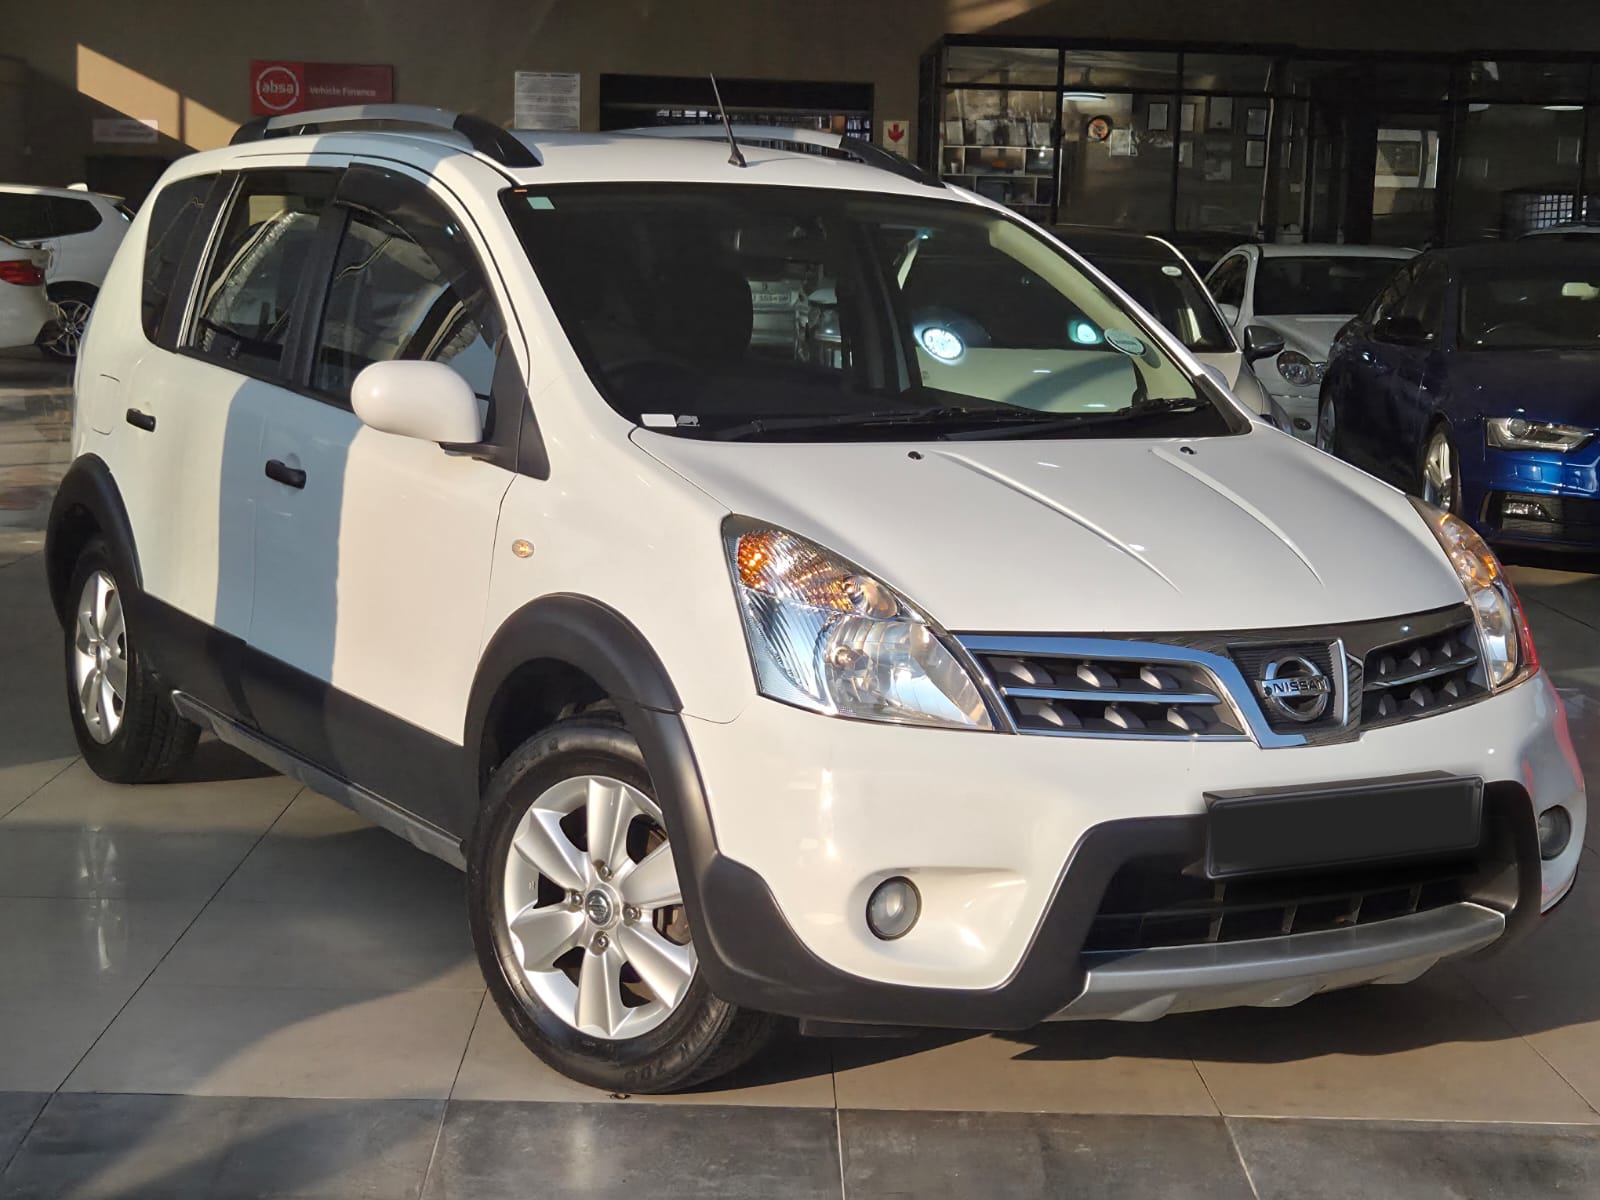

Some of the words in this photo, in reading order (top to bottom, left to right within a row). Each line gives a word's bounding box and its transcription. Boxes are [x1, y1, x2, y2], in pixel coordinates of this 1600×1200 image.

[262, 80, 294, 94] absa
[310, 85, 341, 96] Vehicle
[342, 87, 376, 97] Finance
[1272, 679, 1328, 693] NISSAN
